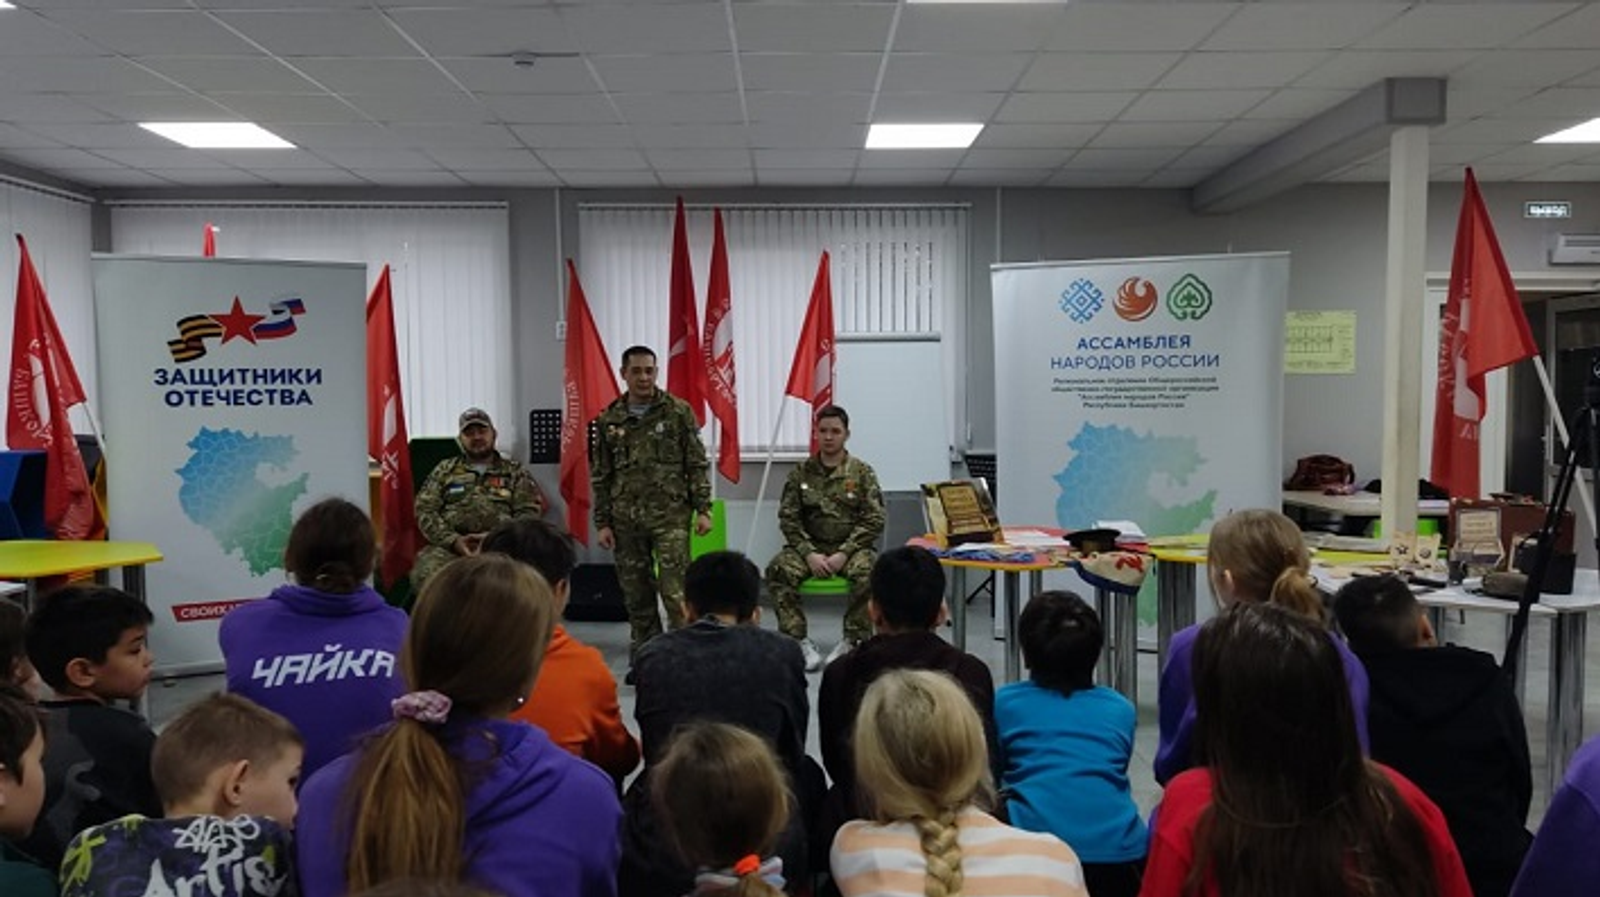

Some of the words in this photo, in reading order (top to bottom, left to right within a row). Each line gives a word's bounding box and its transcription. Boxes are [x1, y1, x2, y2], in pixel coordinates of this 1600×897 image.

[1076, 334, 1191, 350] АССАМБЛЕЯ
[1051, 355, 1136, 371] НАРОДОВ
[1141, 354, 1220, 369] РОССИИ
[153, 368, 322, 387] ЗАЩИТНИКИ
[164, 388, 314, 407] ОТЕЧЕСТВА
[180, 605, 227, 618] СВОИХ
[251, 644, 396, 688] ЧАЙКА
